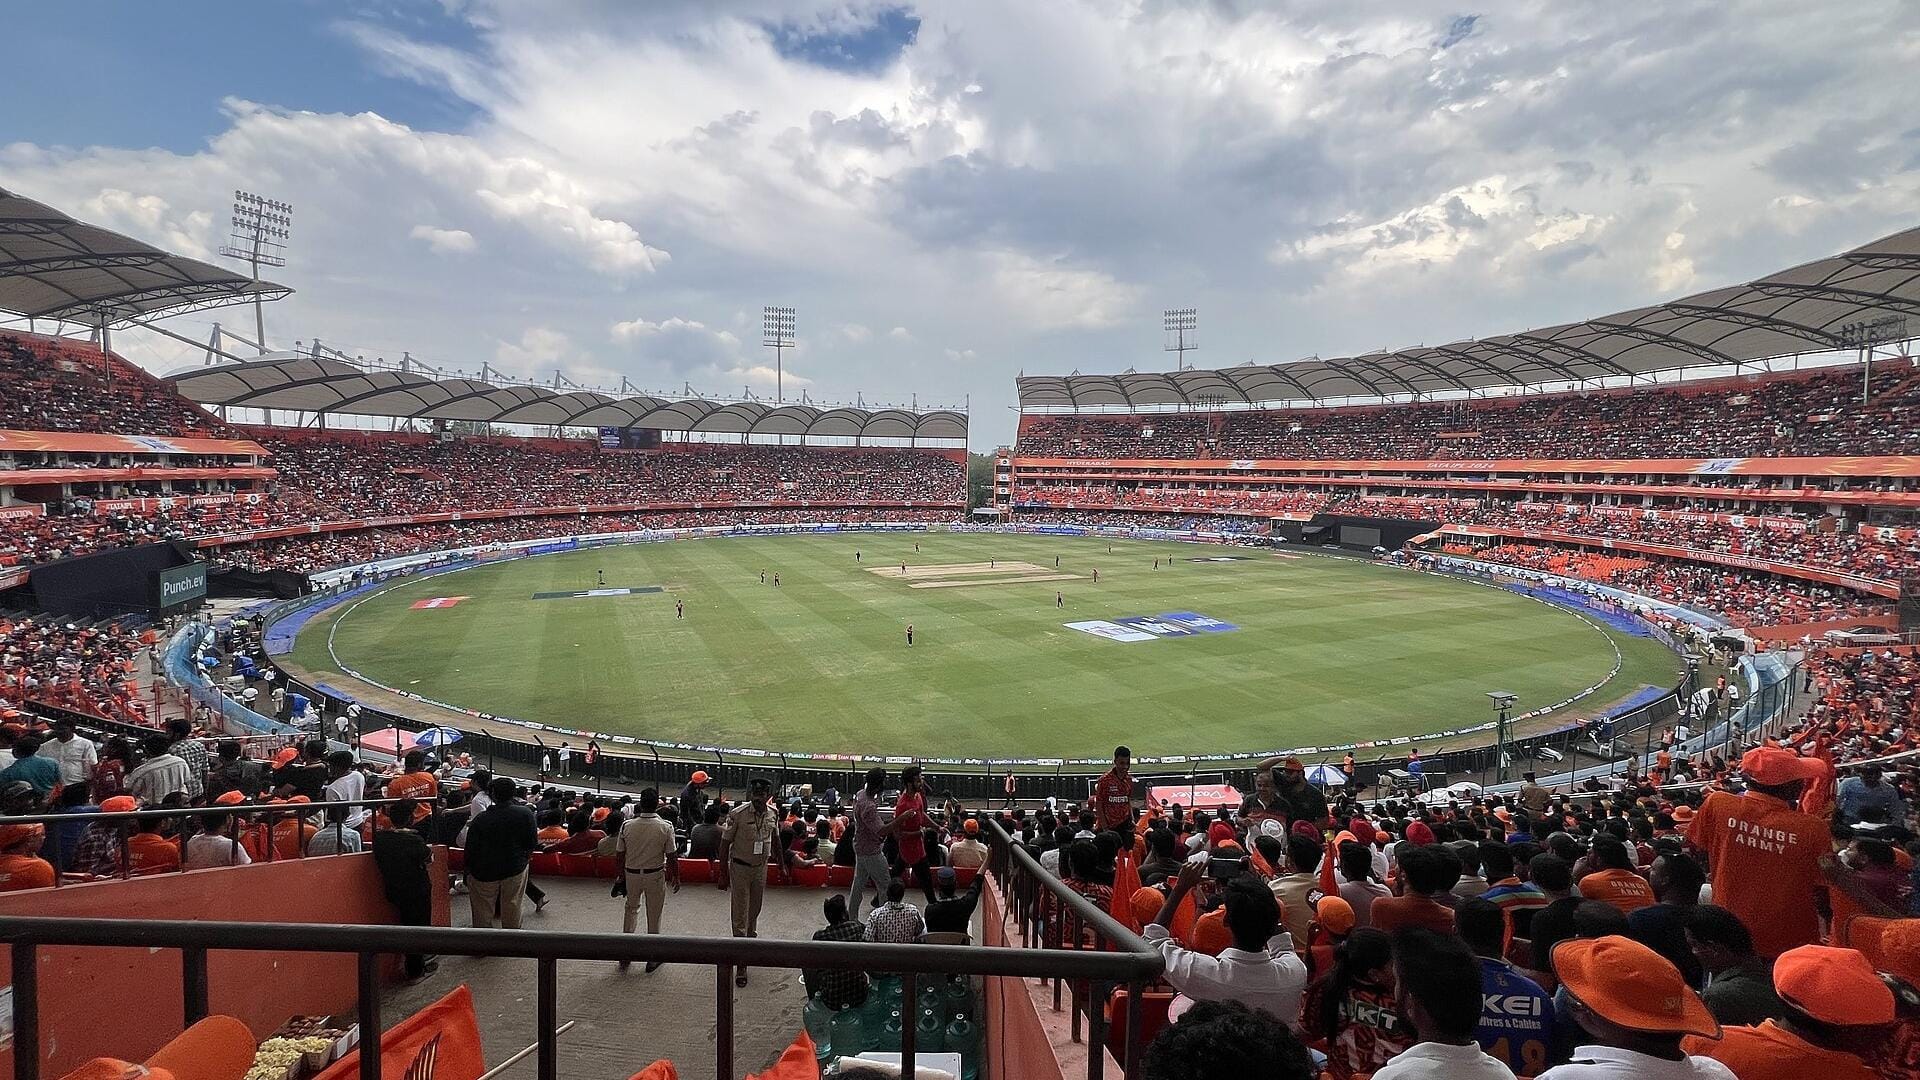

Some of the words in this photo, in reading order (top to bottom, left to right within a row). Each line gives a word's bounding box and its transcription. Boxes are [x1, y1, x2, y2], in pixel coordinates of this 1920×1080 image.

[1751, 561, 1770, 570] STAND
[163, 575, 204, 597] Punch.ev
[1727, 817, 1798, 845] ORANGE
[1736, 833, 1785, 855] ARMY
[1610, 880, 1646, 890] ORANGE
[1481, 993, 1541, 1016] KEI
[1513, 1018, 1541, 1029] Cables
